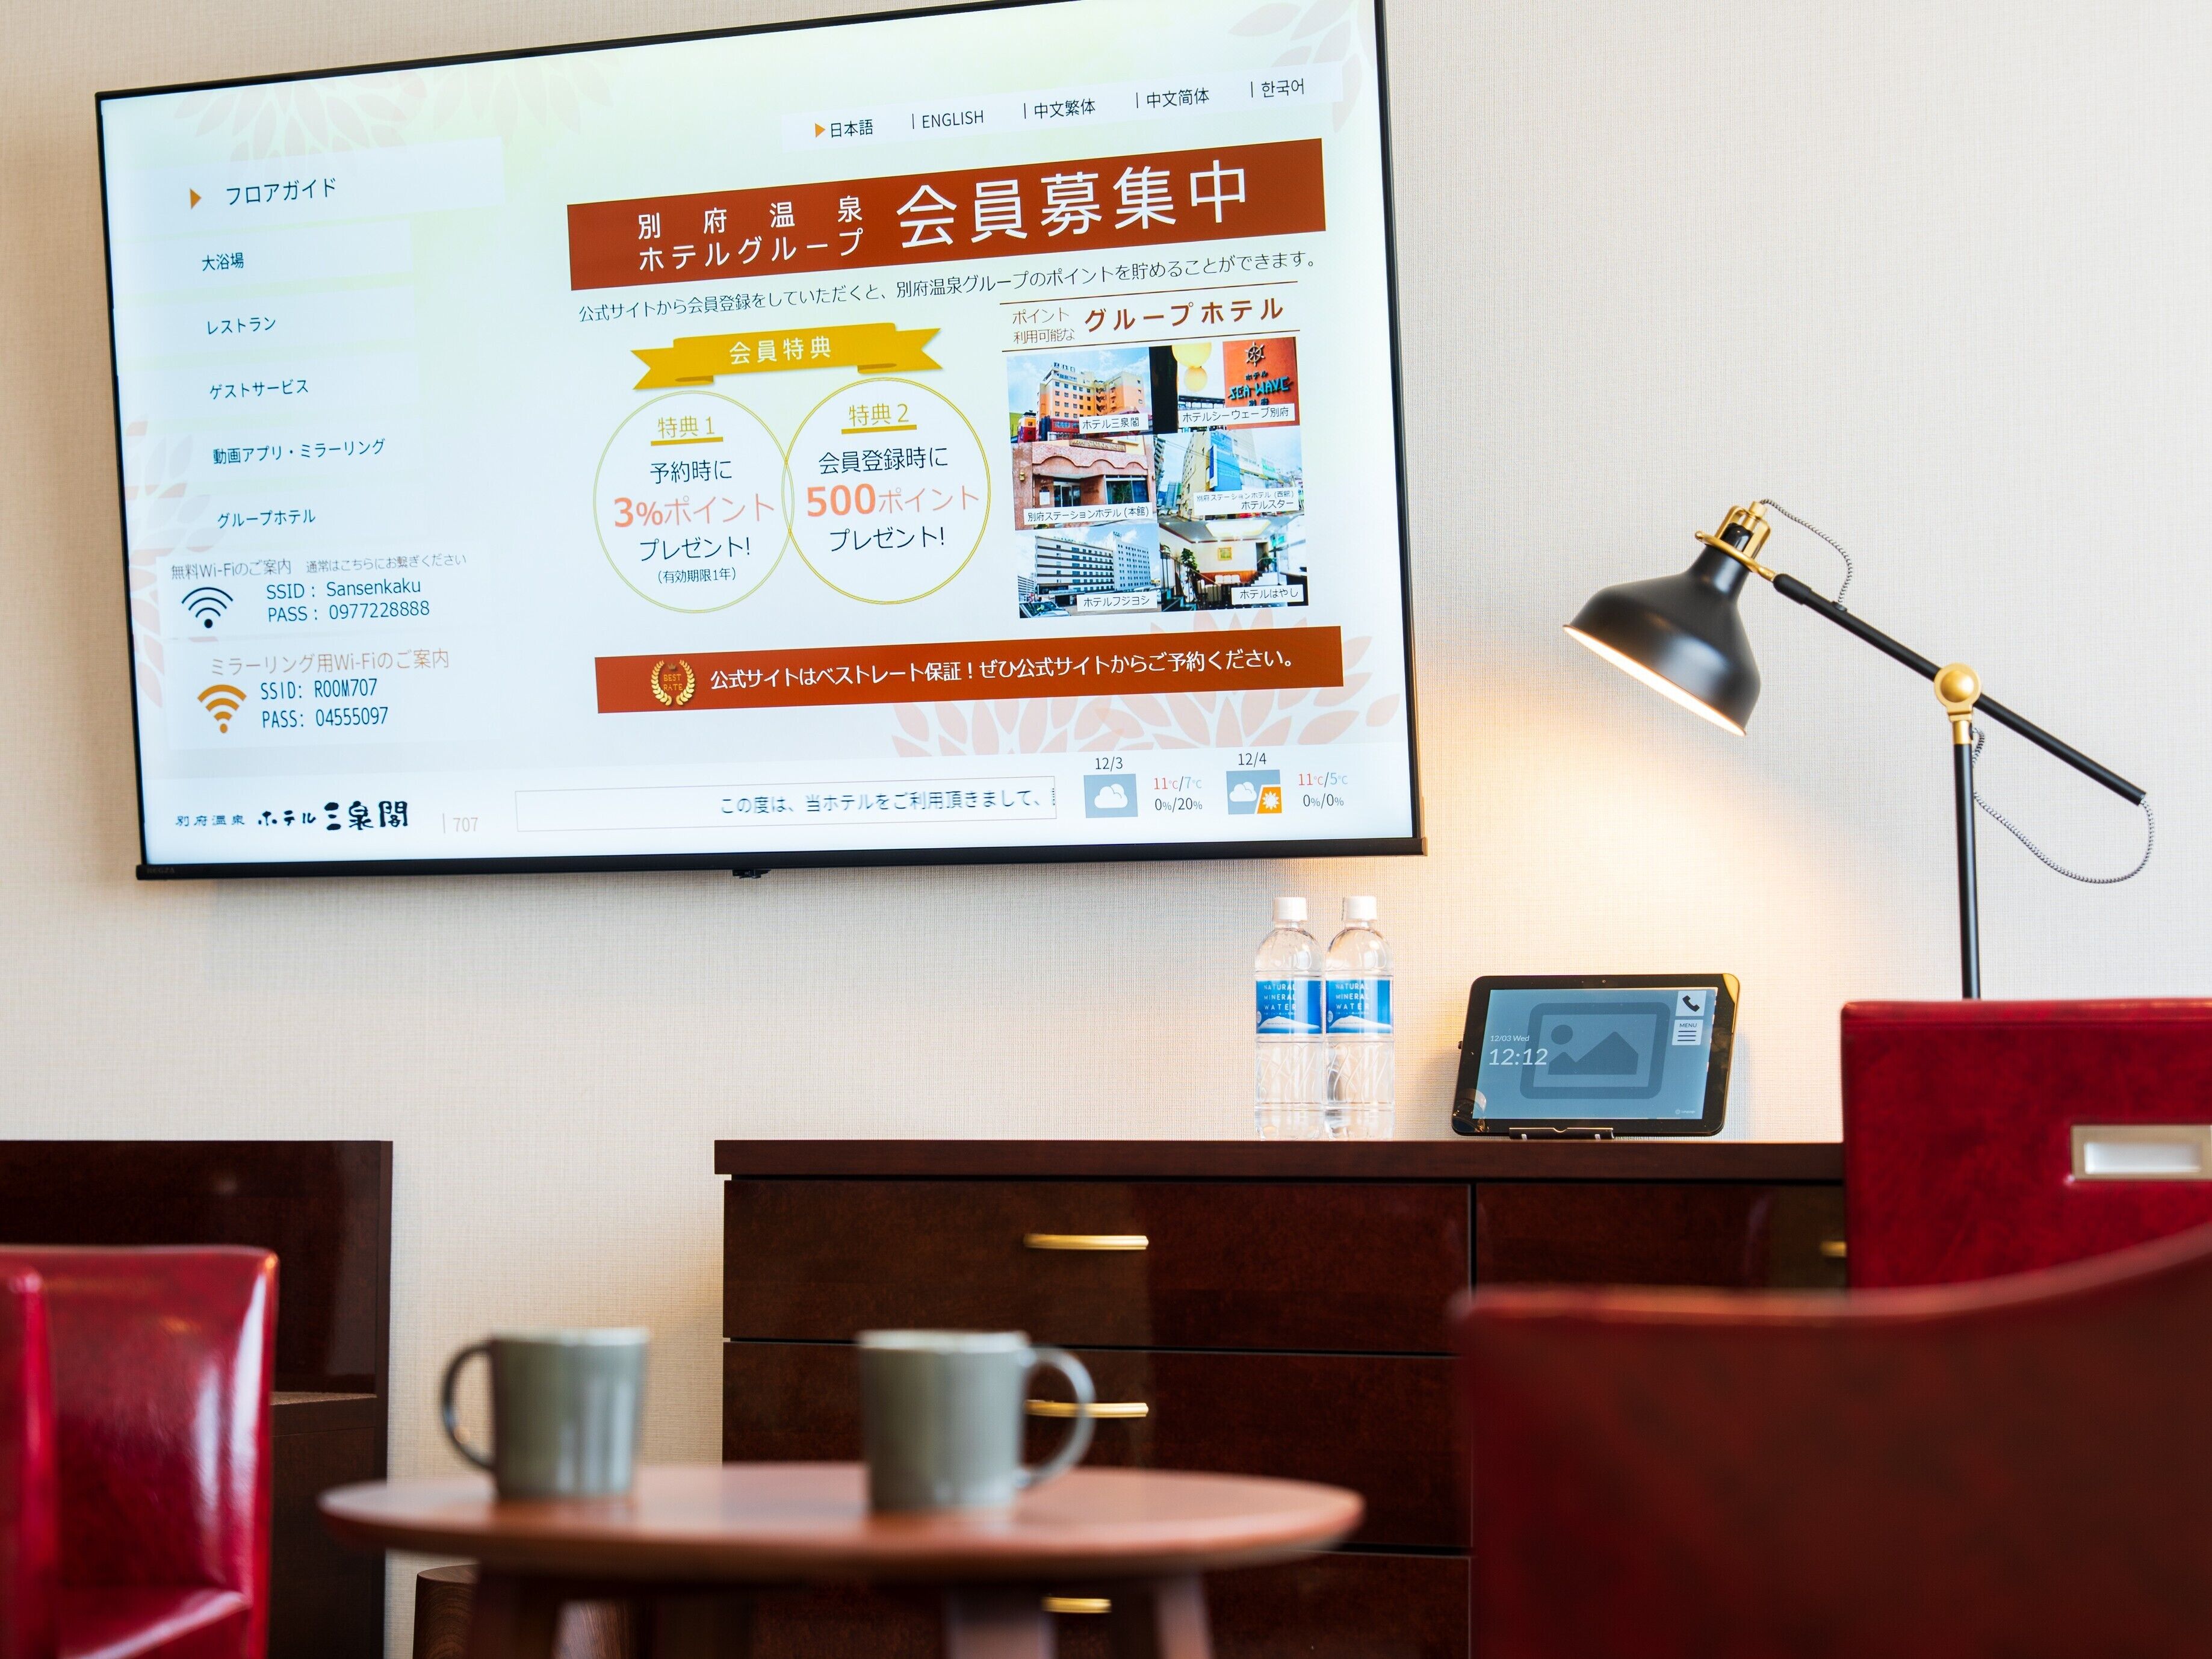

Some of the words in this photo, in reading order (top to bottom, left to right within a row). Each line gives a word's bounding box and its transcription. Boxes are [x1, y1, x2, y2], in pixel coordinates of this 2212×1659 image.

[1147, 88, 1209, 108] 中文简体
[1261, 78, 1304, 99] 한국어
[1034, 98, 1095, 119] 中文繁体
[831, 119, 873, 138] 日本語
[922, 110, 984, 128] ENGLISH
[226, 178, 337, 205] フロアガイド
[896, 159, 1245, 249] 会員募集中
[639, 229, 864, 273] ホテルグループ
[202, 253, 244, 271] 大浴場
[1012, 307, 1069, 324] ポイント
[1085, 298, 1284, 332] グループホテル
[206, 317, 276, 335] レストラン
[1014, 328, 1075, 344] 利用可能な
[729, 336, 831, 365] 会員特典
[209, 379, 309, 399] ゲストサービス
[1082, 417, 1139, 430] ホテル三泉閣
[1183, 407, 1289, 423] ホテルシーウェーブ別府
[212, 438, 386, 465] 動画アプリ・ミラーリング
[818, 446, 948, 476] 会員登録時に
[649, 460, 732, 485] 予約時に
[807, 483, 979, 517] 500ポイント
[1241, 499, 1293, 510] ホテルスター
[217, 508, 316, 529] グループホテル
[613, 493, 775, 528] 3%ポイント
[639, 537, 750, 562] プレゼント!
[830, 527, 944, 552] プレゼント!
[171, 559, 291, 580] 無料Wi-Fiのご案内
[657, 567, 736, 584] (有効期限1年)
[327, 578, 421, 597] Sansenkaku
[1240, 588, 1298, 600] ホテルはやし
[329, 601, 430, 620] 0977228888
[1083, 595, 1150, 607] ホテルフジヨシ
[211, 648, 450, 675] ミラーリング用Wi-Fiのご案内
[261, 681, 302, 700] SSID:
[262, 710, 304, 728] PASS:
[315, 707, 388, 727] 04555097
[1095, 757, 1123, 772] 12/3
[1238, 752, 1267, 767] 12/4
[721, 787, 1055, 814] この度は、当ホテルをご利用頂きまして、
[1154, 797, 1203, 813] 0%/20%
[1303, 793, 1344, 809] 0%/0%
[176, 815, 245, 826] 別府温泉
[258, 801, 408, 831] ホテル三泉閣
[453, 817, 478, 832] 707
[1489, 1048, 1548, 1065] 12:12
